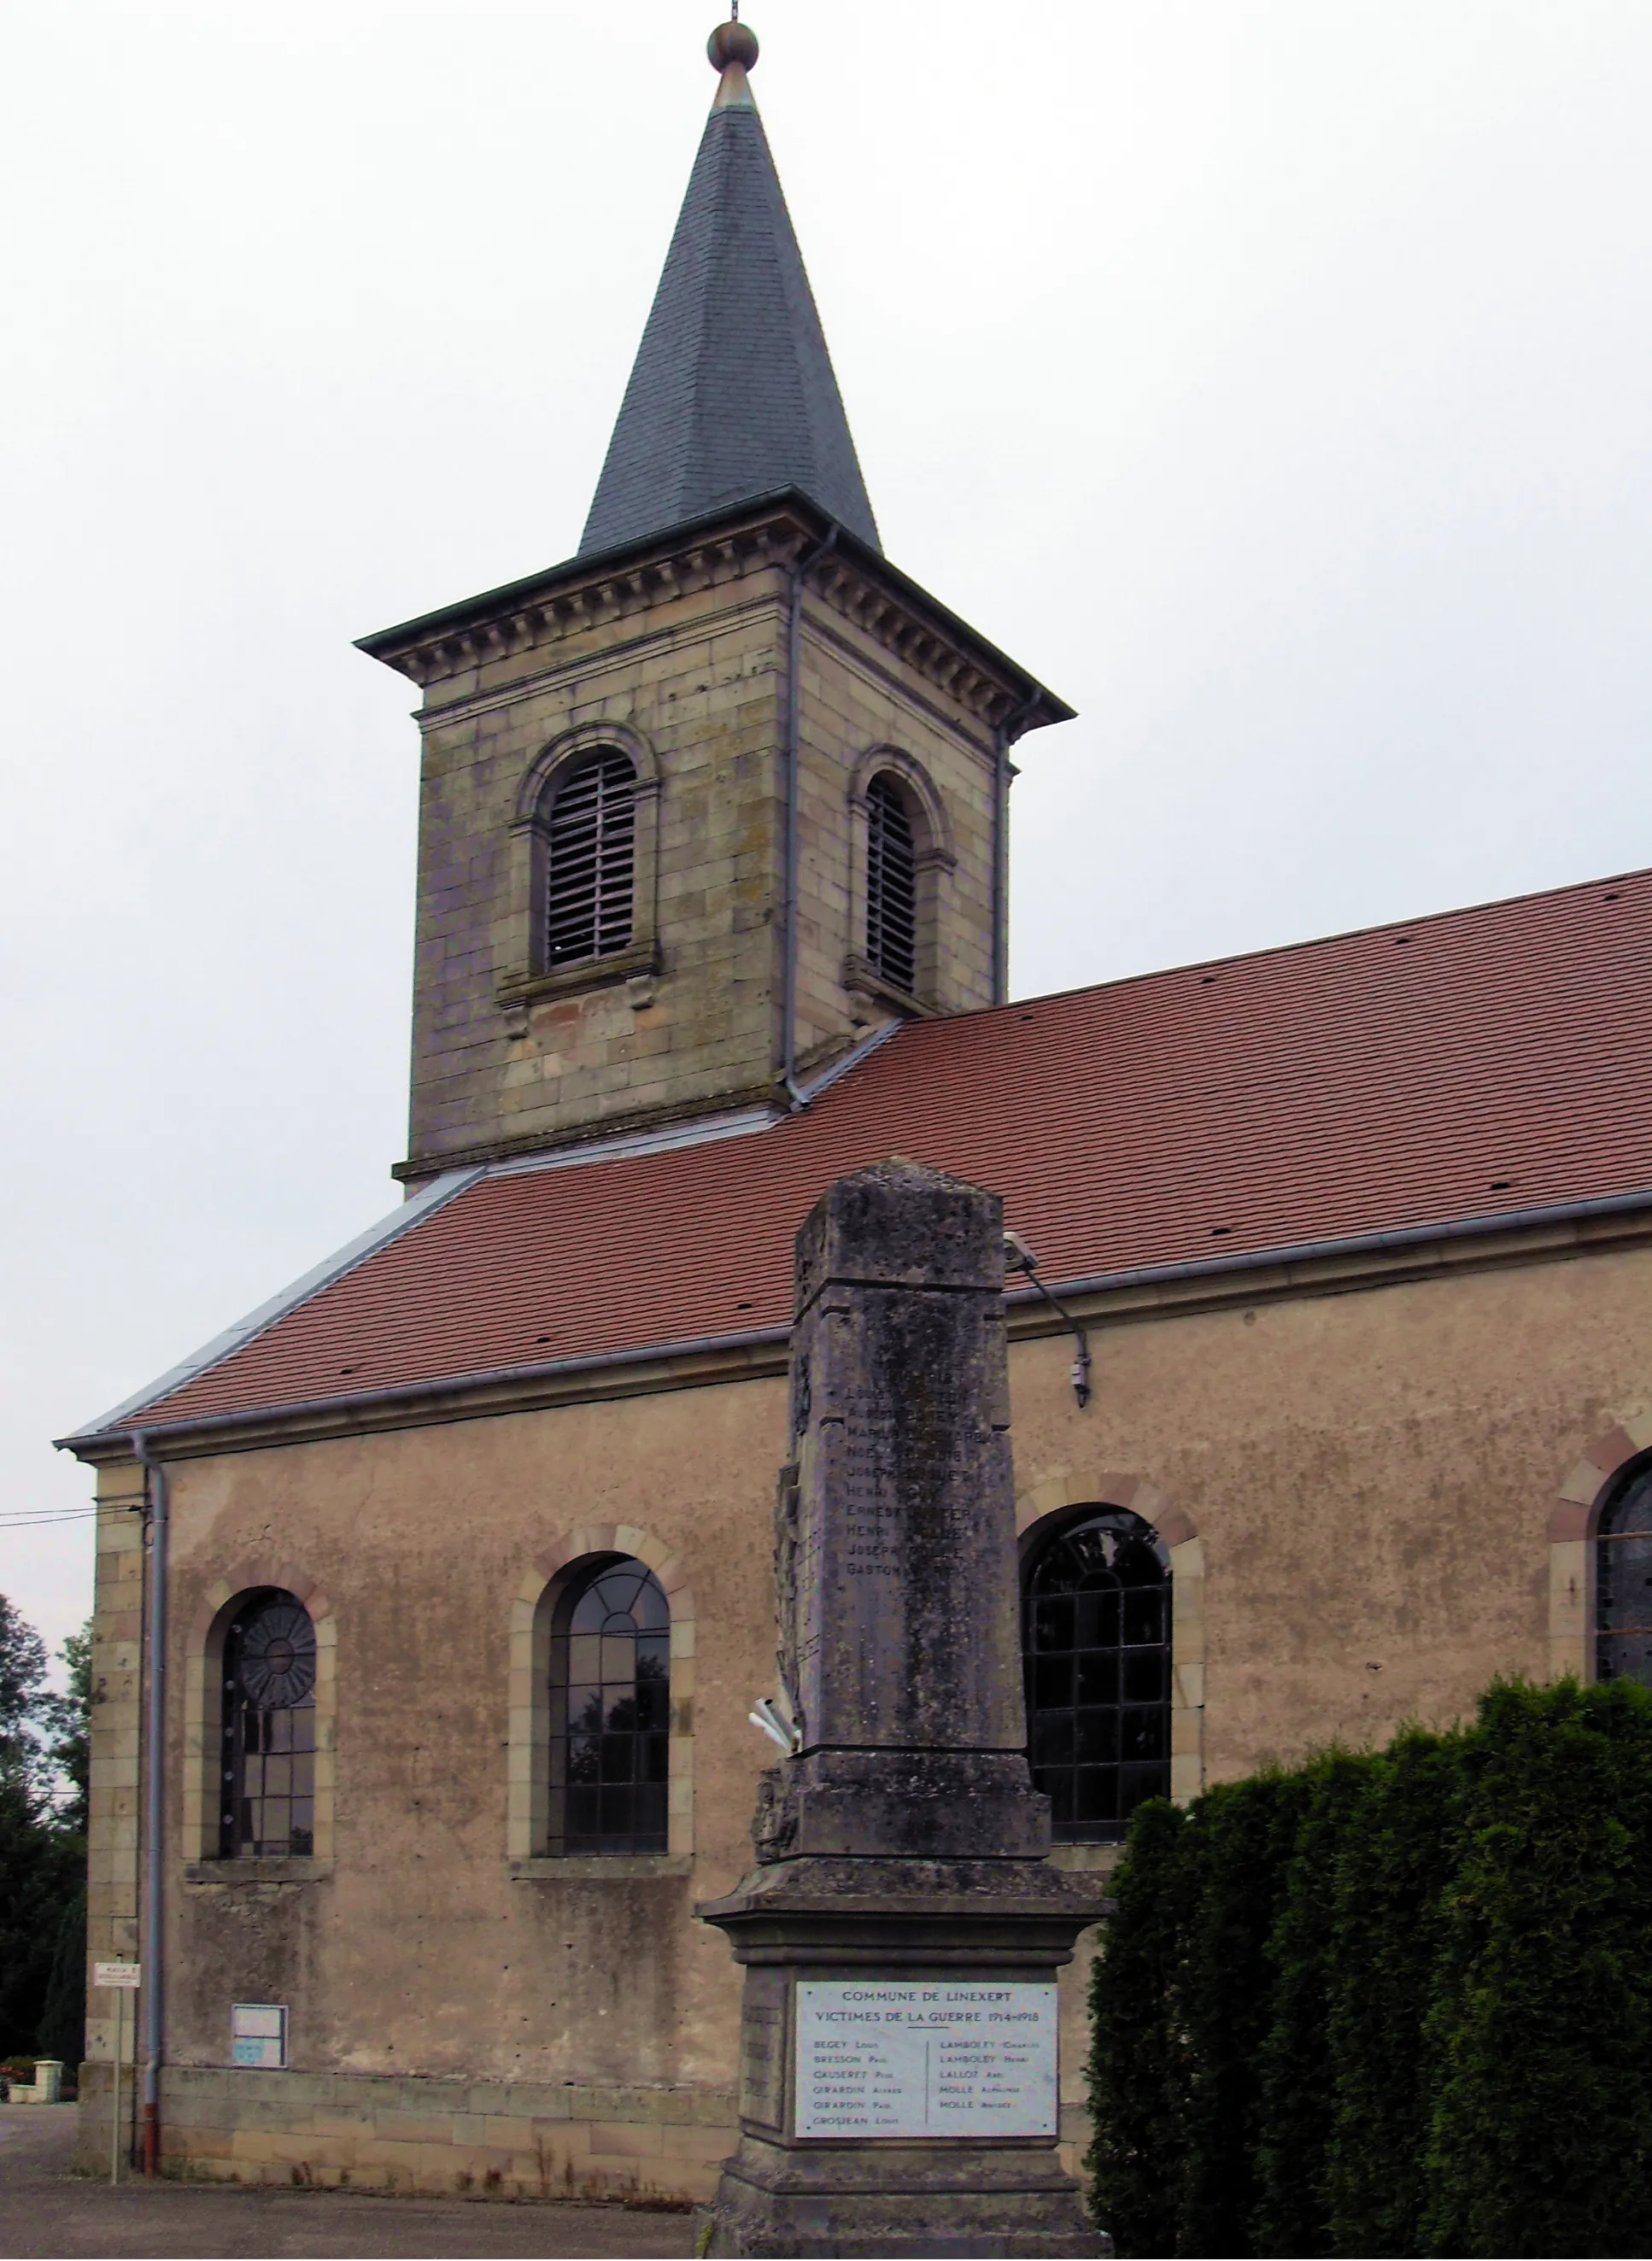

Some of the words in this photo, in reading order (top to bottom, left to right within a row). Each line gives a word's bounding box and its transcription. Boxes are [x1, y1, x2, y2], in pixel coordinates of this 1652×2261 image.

[847, 1504, 902, 1518] ERNEST
[847, 1562, 902, 1576] GASTON
[842, 1991, 917, 2001] COMMUNE
[923, 1992, 940, 2001] DE
[946, 1992, 1011, 2001] LINEXERT
[816, 2012, 881, 2022] VICTIMES
[885, 2012, 903, 2022] DE
[908, 2012, 924, 2022] LA
[929, 2012, 982, 2022] GUERRE
[988, 2012, 1040, 2022] 1914-1918
[813, 2055, 861, 2064] BRESSON
[812, 2086, 865, 2094] GIRARDIN
[812, 2101, 865, 2110] GIRARDIN
